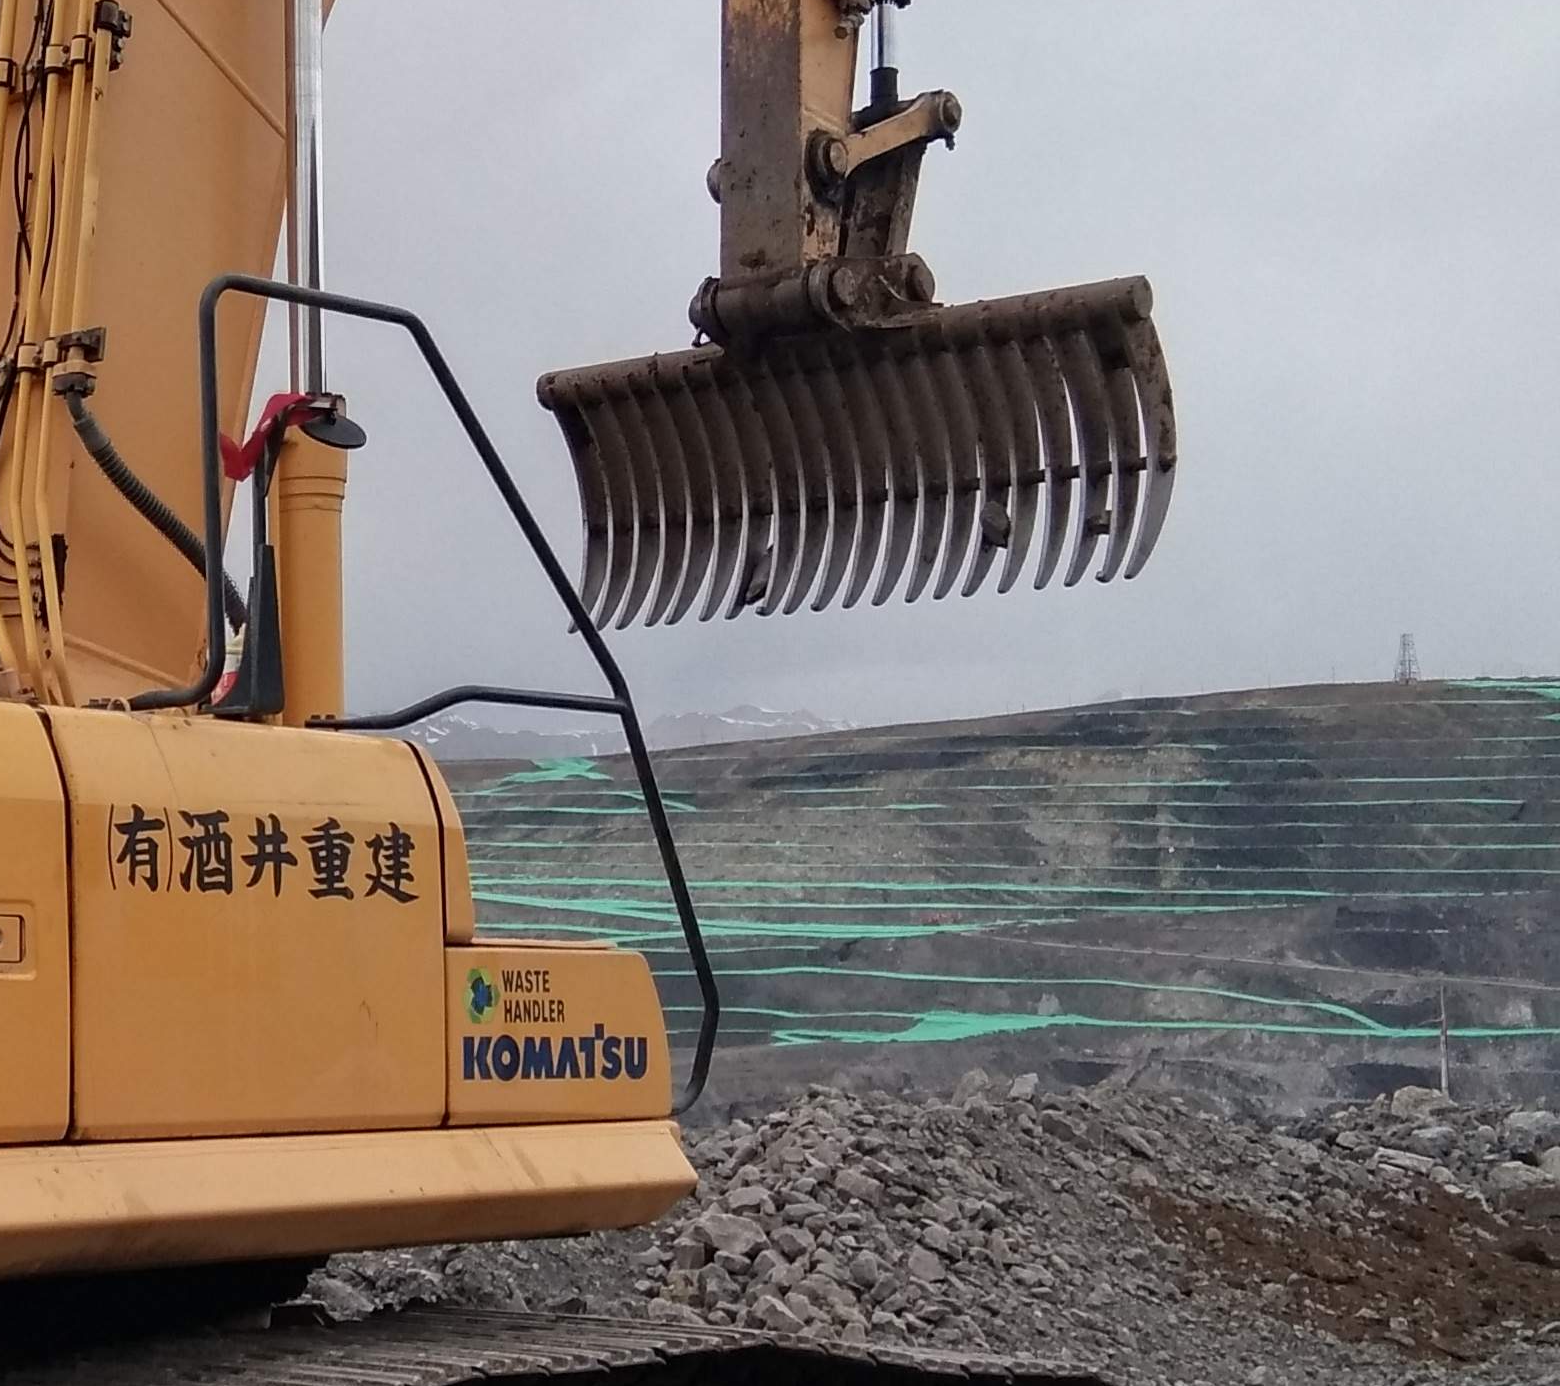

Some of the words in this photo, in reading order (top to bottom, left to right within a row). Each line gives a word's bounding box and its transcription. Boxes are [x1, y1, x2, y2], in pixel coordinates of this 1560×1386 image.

[502, 970, 550, 994] WASTE
[504, 999, 565, 1024] HANDLER
[463, 1023, 648, 1082] KOMATSU
